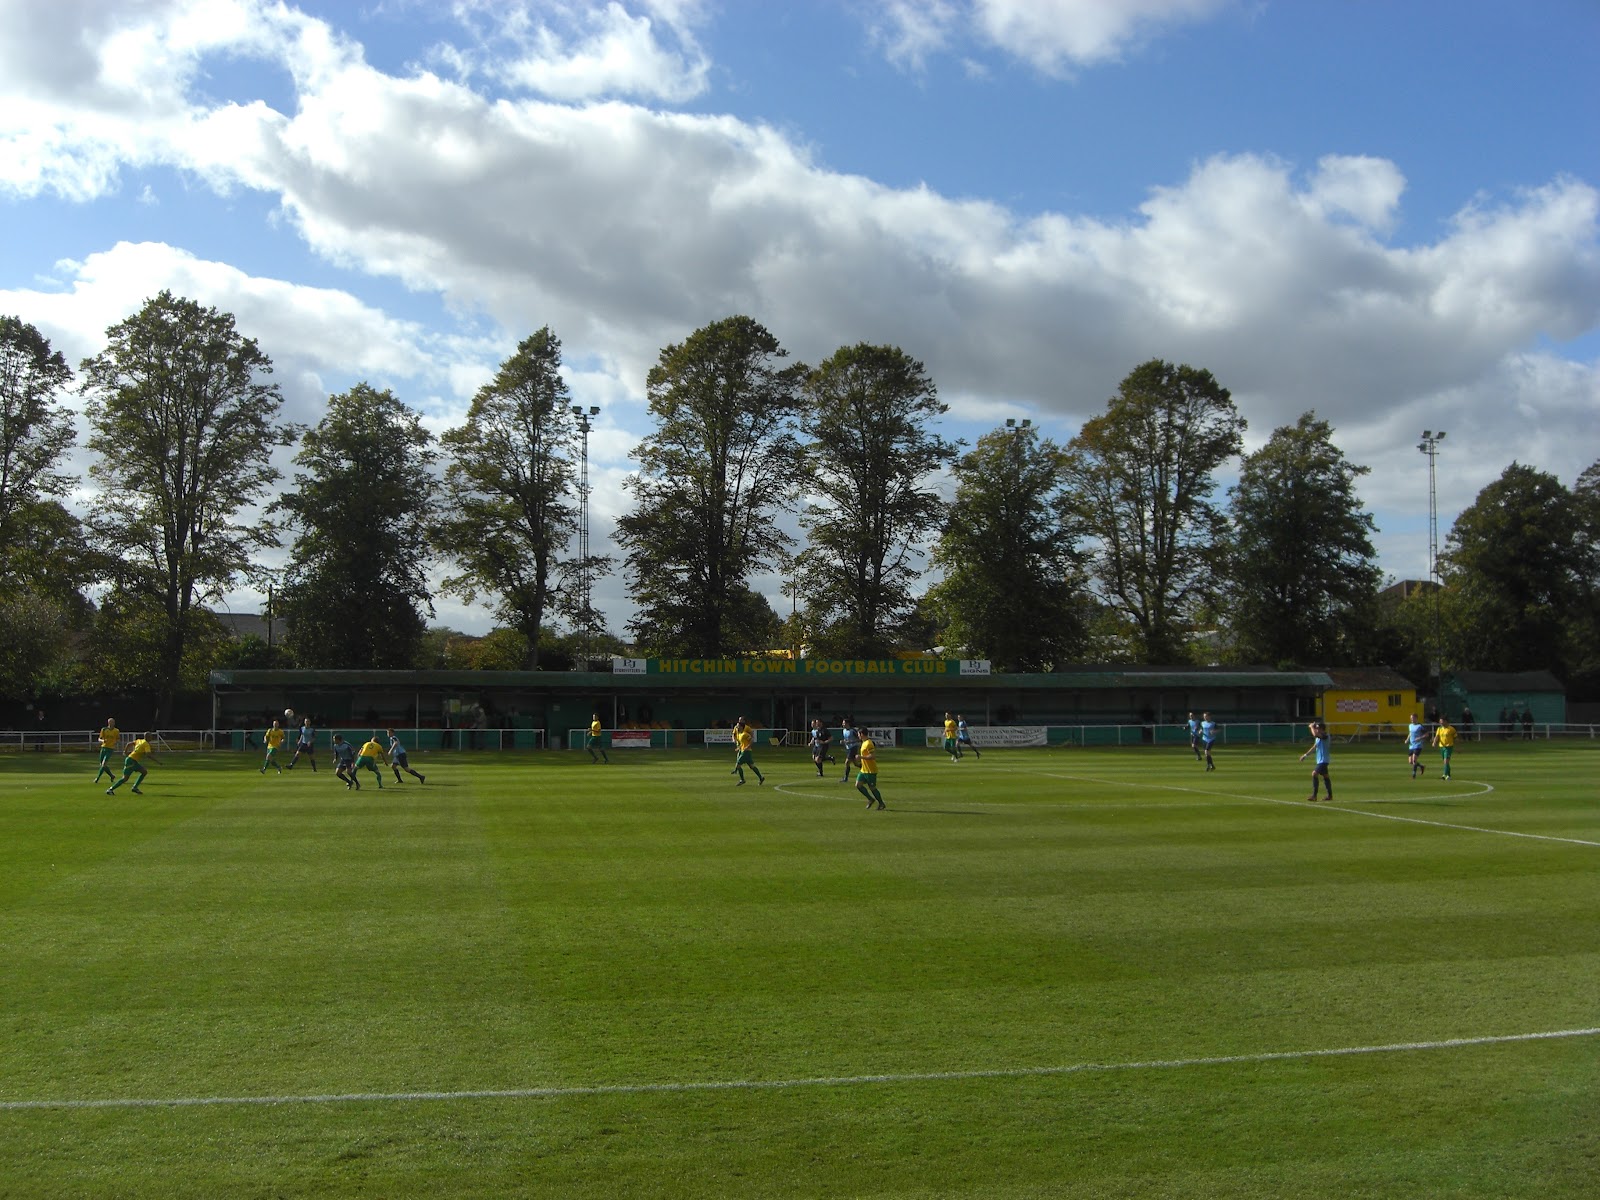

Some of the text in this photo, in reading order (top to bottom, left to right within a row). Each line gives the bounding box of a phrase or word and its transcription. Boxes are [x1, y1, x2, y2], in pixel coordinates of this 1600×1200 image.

[660, 660, 947, 674] HITCHIN TOWN FOOTBALL CLUB
